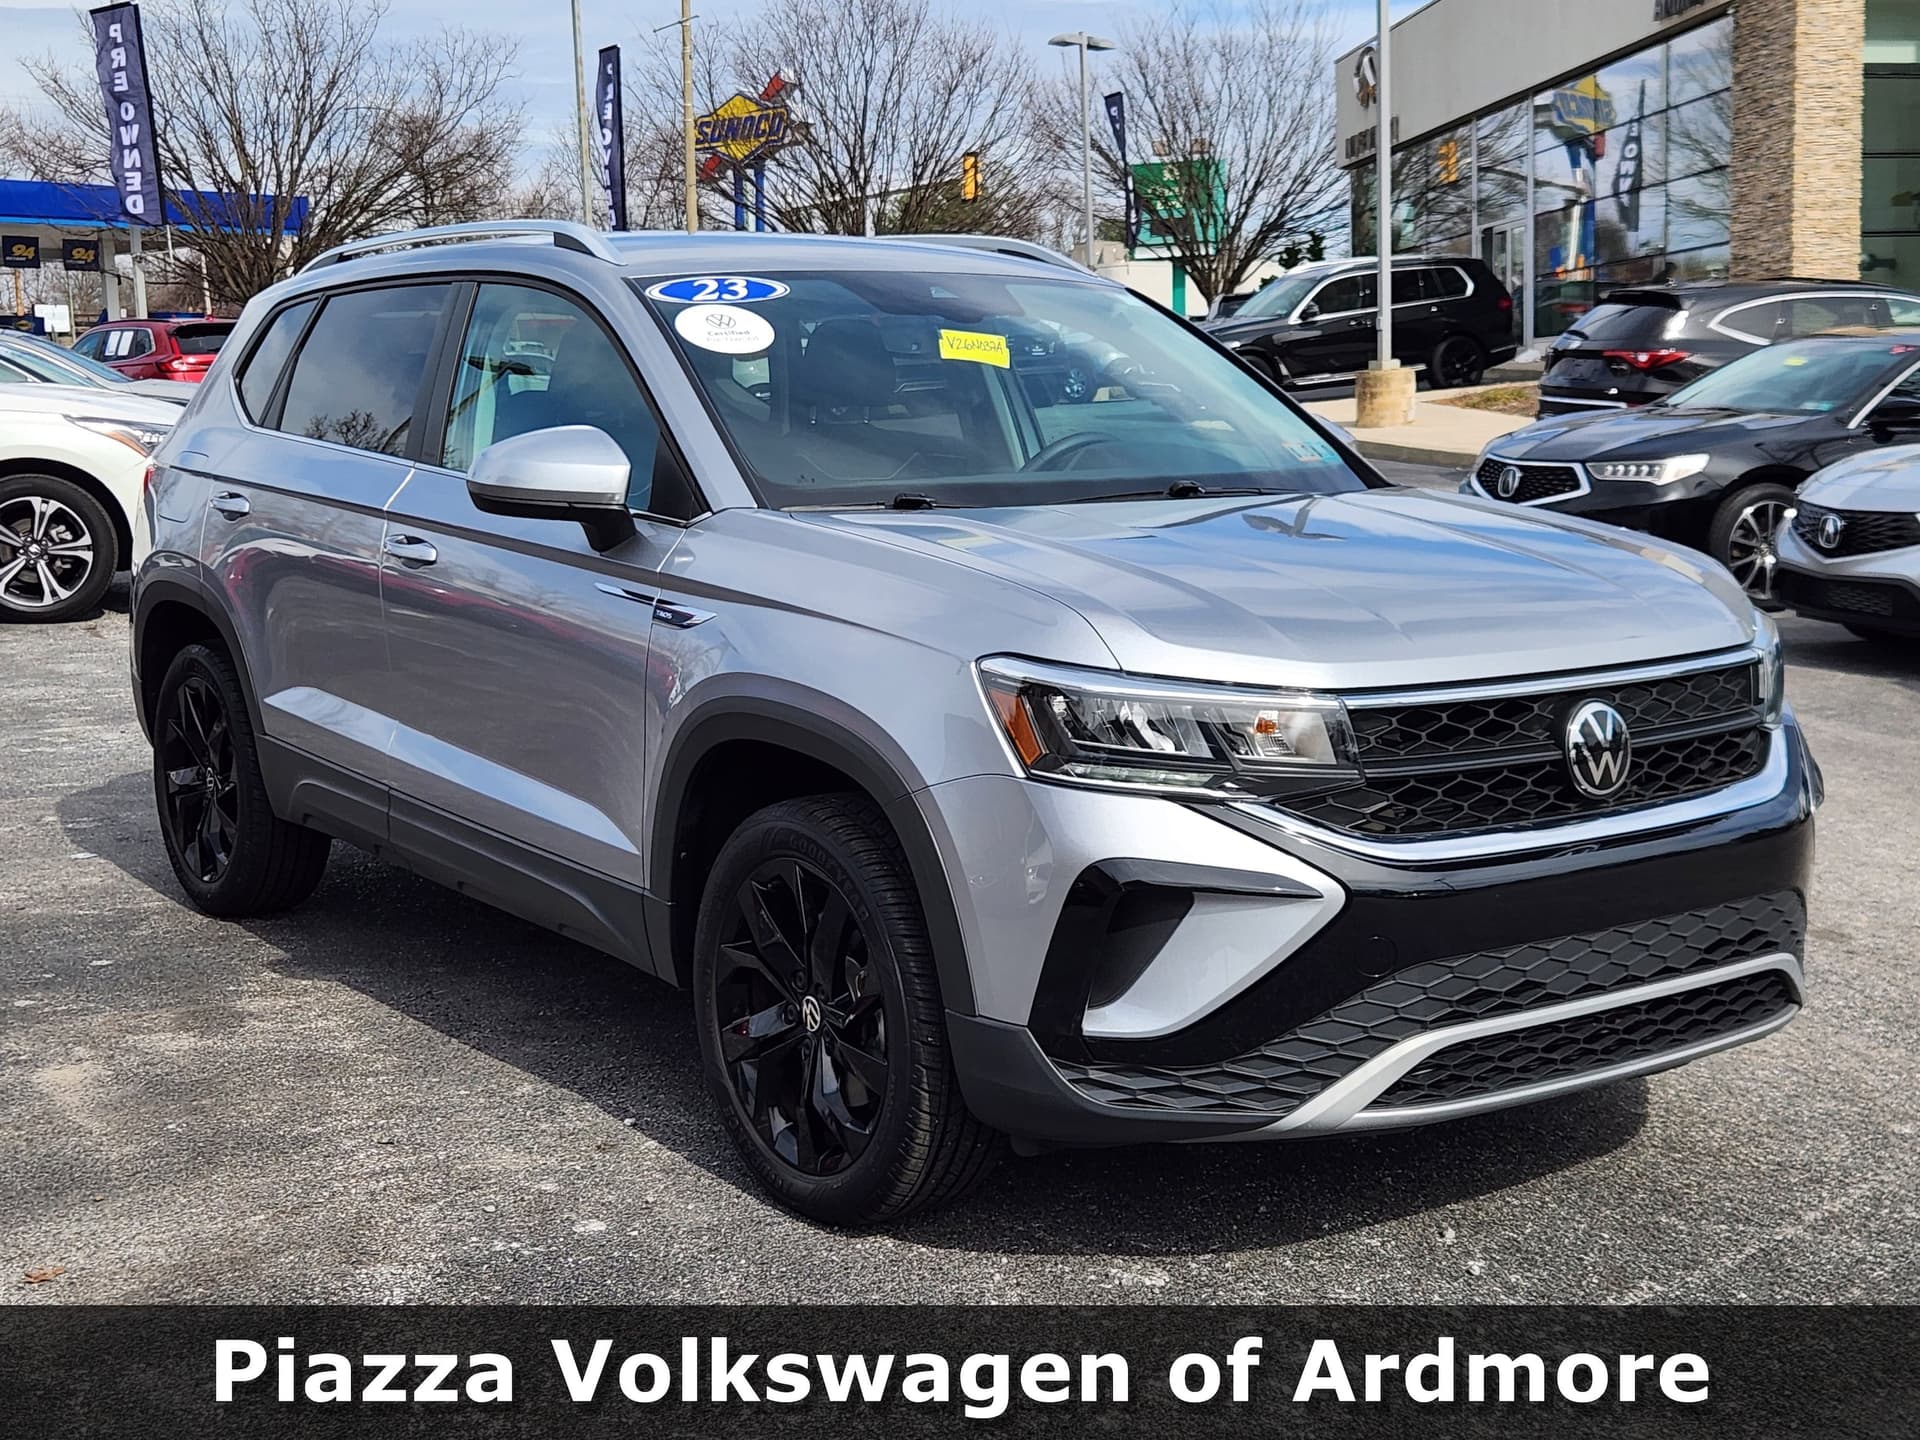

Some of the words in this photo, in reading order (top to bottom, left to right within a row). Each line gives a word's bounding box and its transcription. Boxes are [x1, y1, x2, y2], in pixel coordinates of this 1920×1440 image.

[696, 111, 786, 144] SUNOCO
[12, 243, 36, 260] 94
[71, 247, 95, 263] 94
[691, 279, 748, 301] 23
